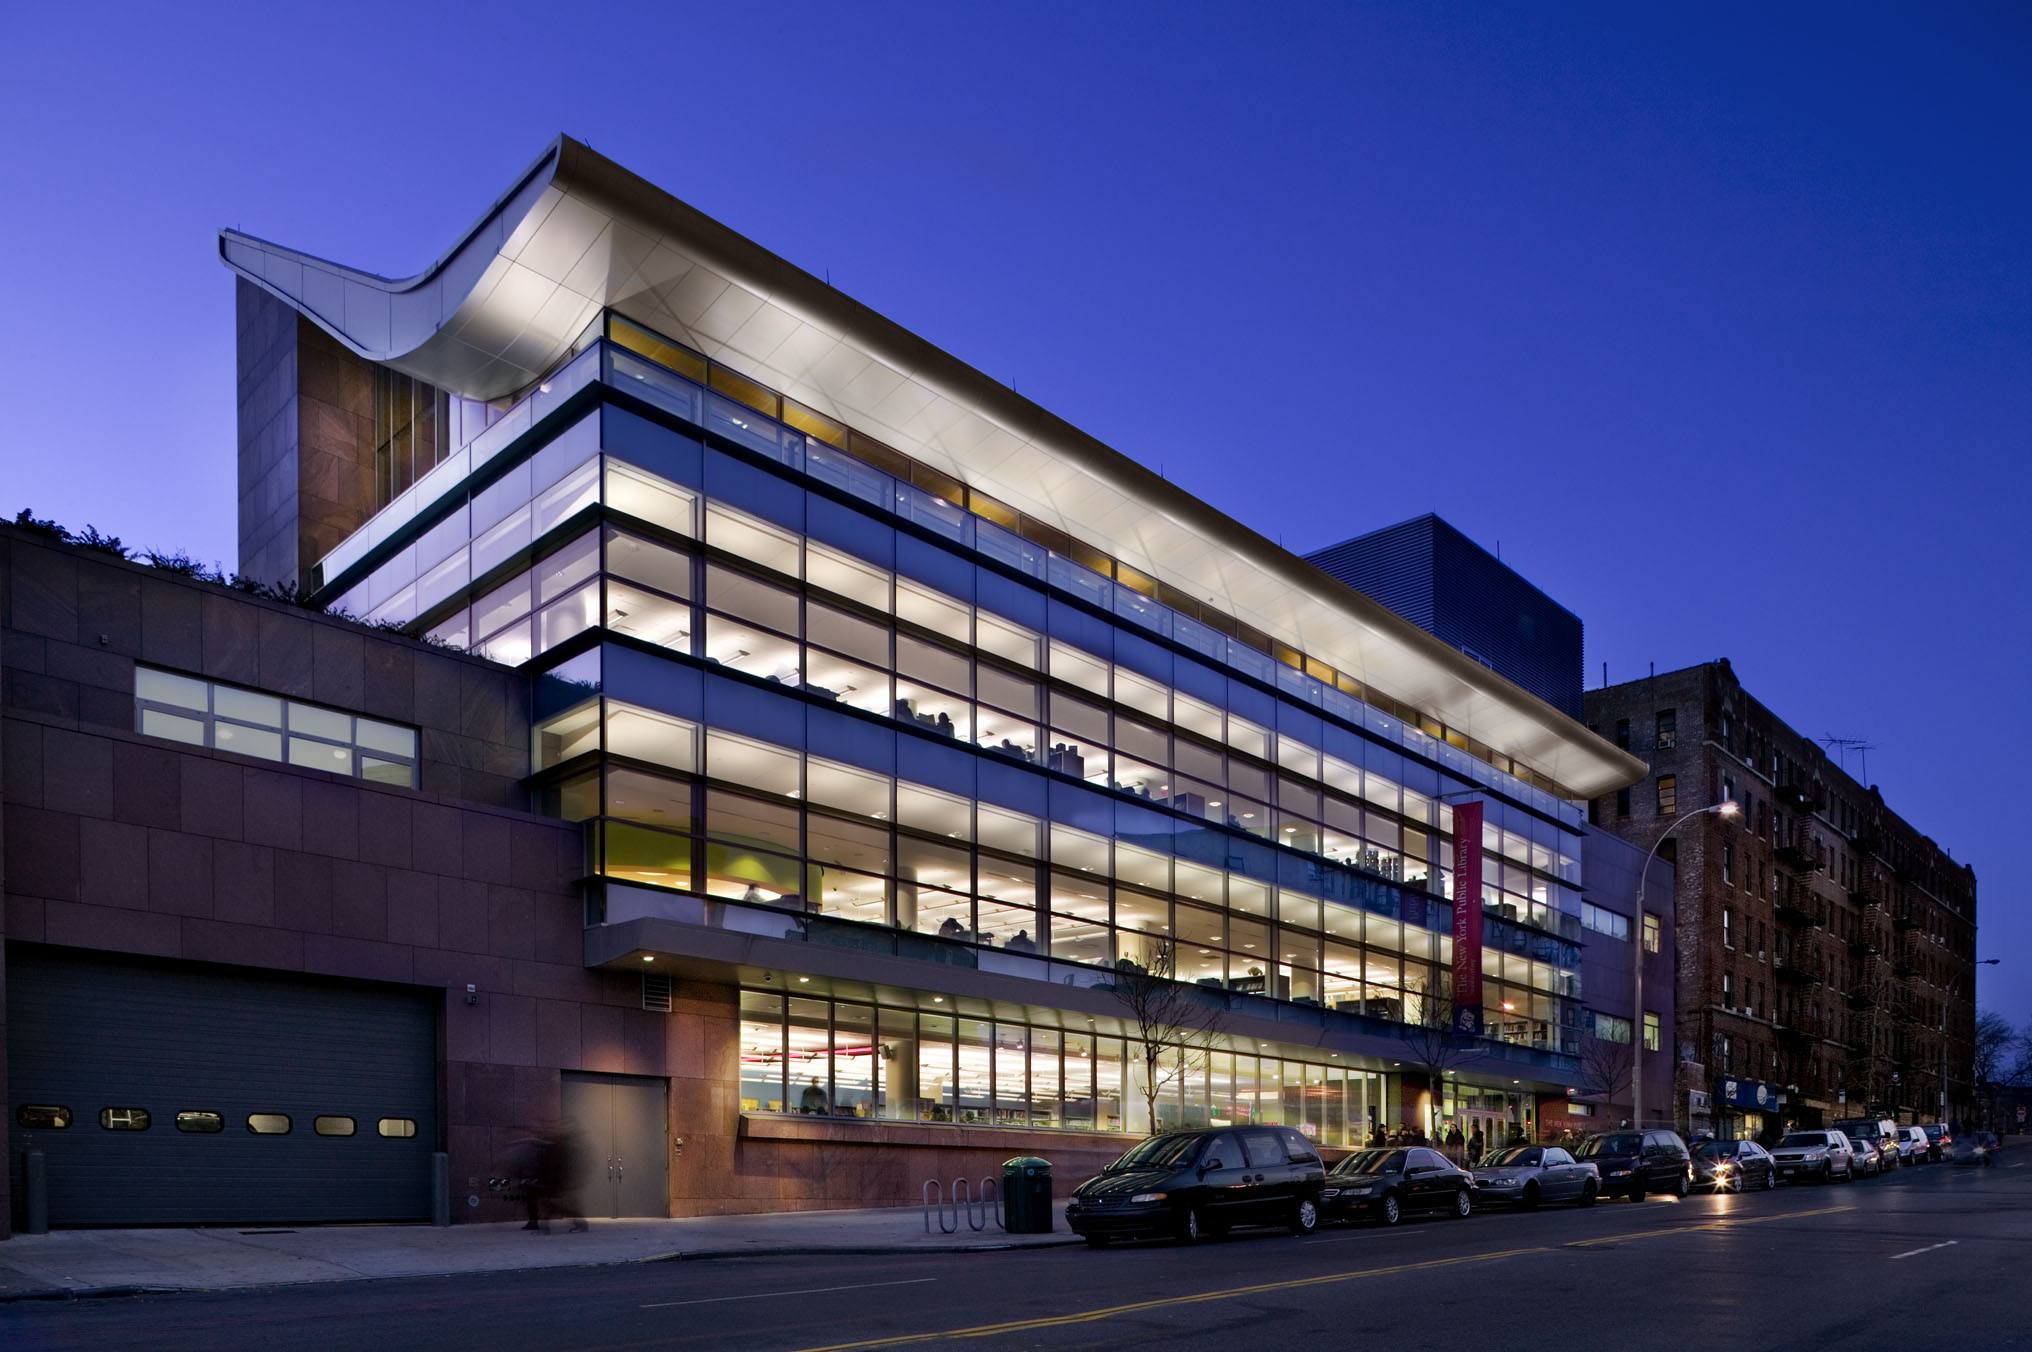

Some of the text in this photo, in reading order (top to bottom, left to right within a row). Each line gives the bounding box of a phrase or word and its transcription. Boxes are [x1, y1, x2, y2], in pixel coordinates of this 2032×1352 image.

[1456, 838, 1471, 994] The New York Public Library
